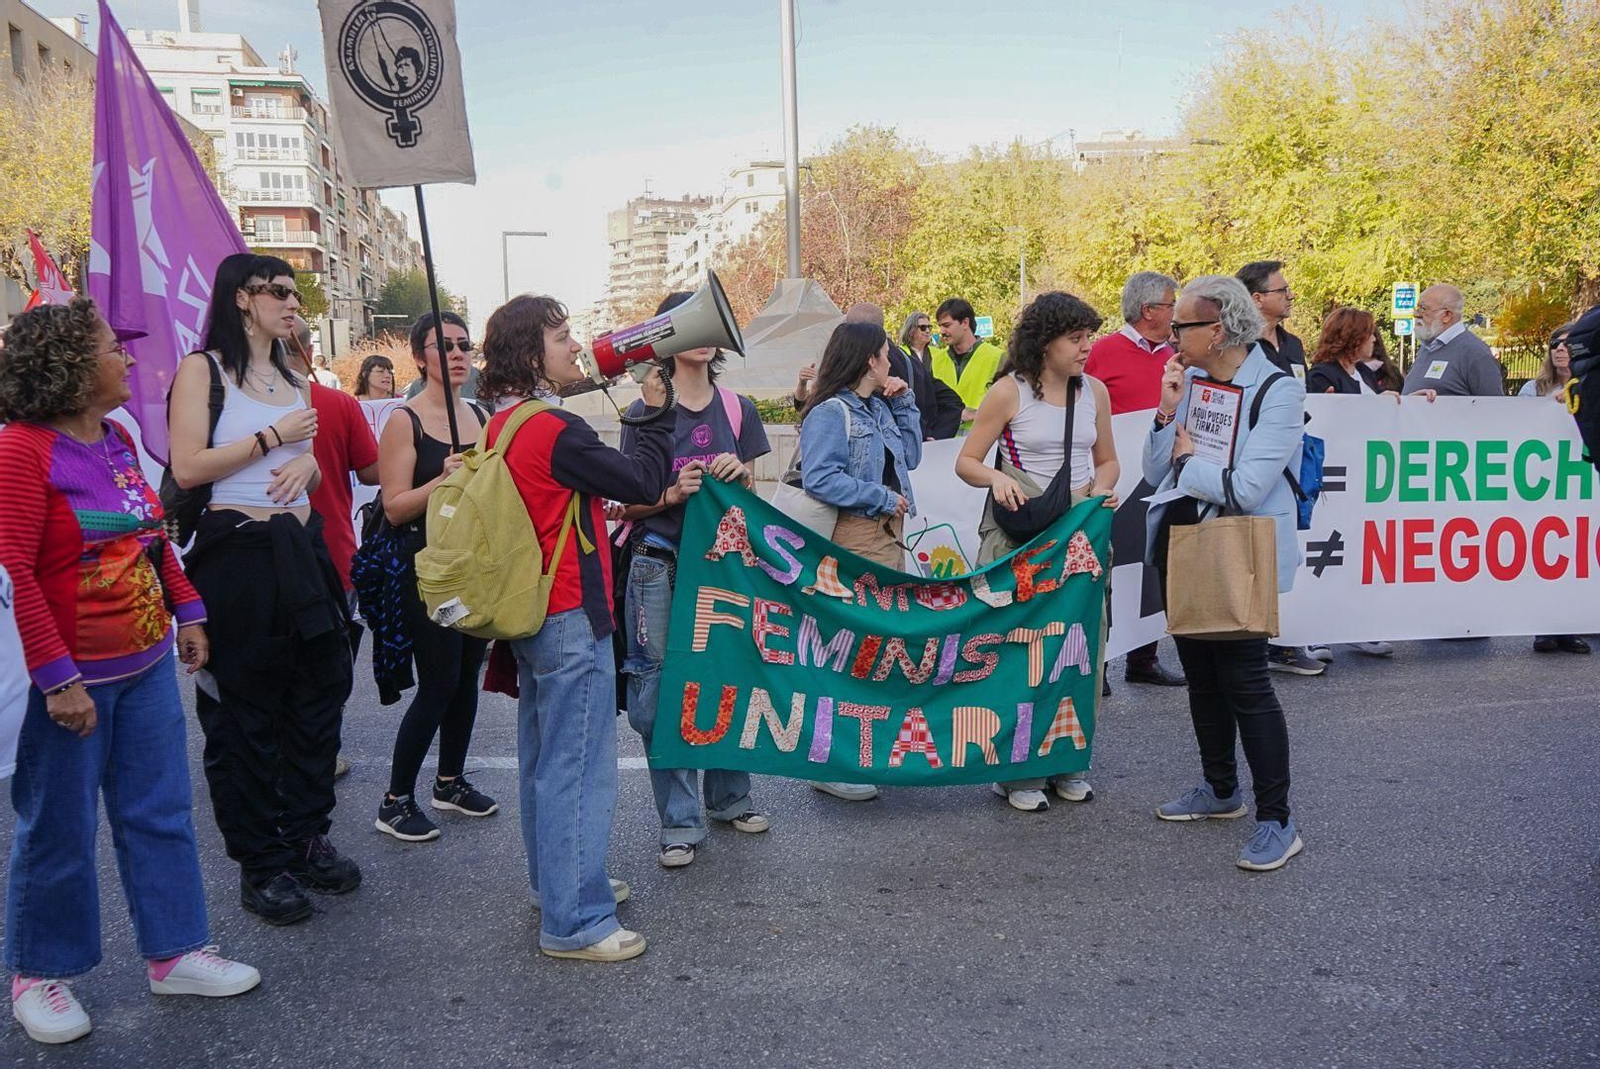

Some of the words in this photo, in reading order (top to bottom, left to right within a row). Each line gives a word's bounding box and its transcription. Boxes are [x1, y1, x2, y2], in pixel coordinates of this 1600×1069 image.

[346, 14, 366, 71] ASAMBLEA
[393, 80, 433, 107] FEMINISTA
[422, 27, 438, 77] UNITARIA
[1195, 419, 1222, 436] FIRMAR!
[1207, 410, 1232, 427] PUEDES
[1365, 439, 1600, 503] DERECH
[1361, 516, 1600, 585] NEGOCI
[692, 586, 1092, 688] FEMINISTA
[680, 681, 1088, 768] UNITARIA
